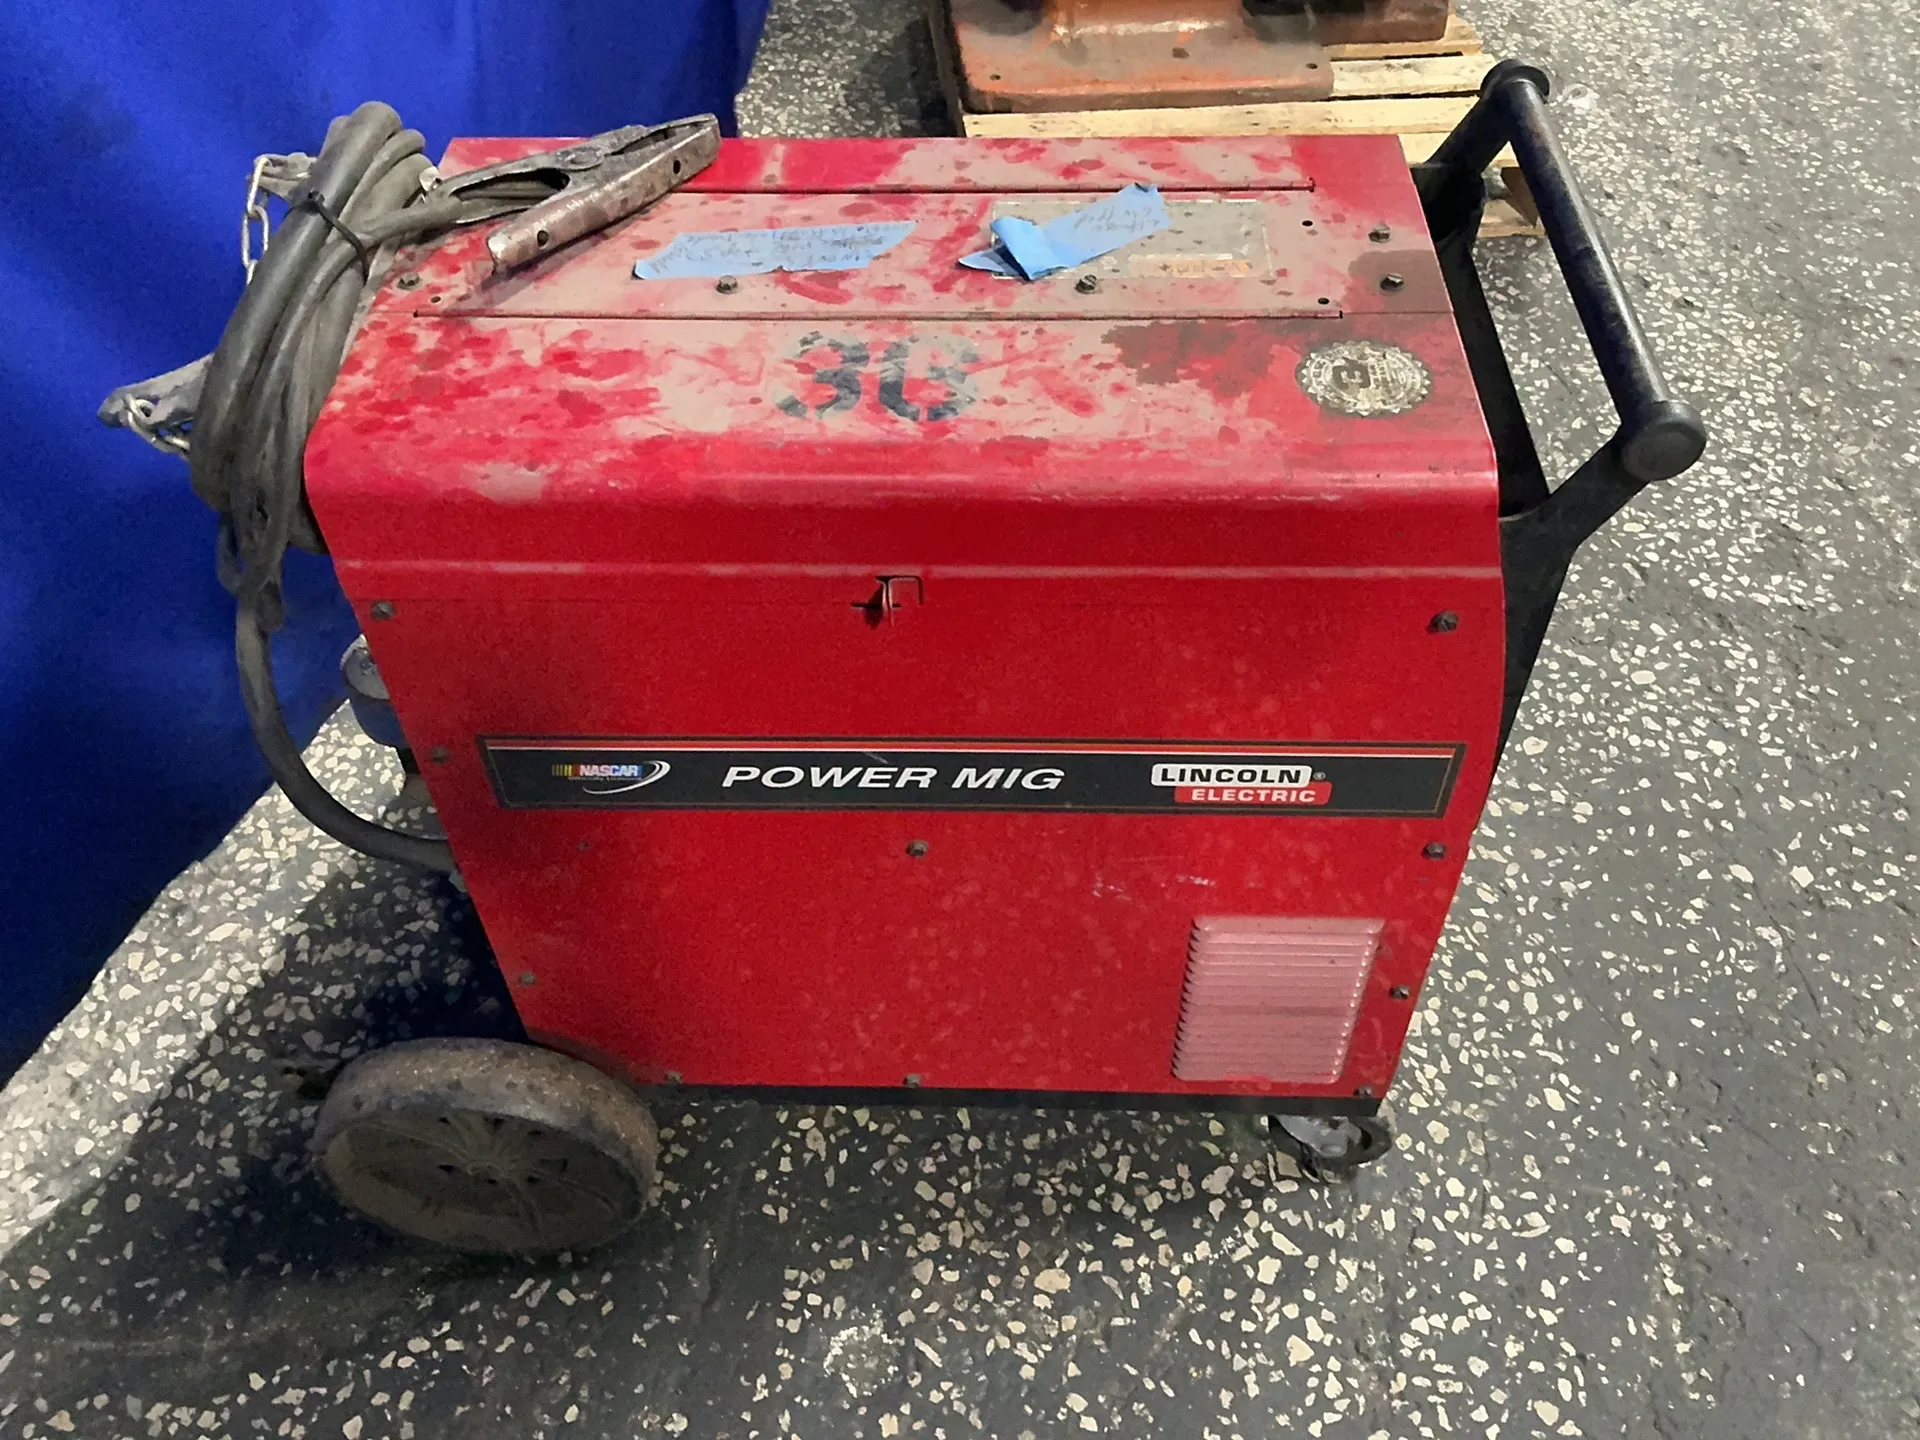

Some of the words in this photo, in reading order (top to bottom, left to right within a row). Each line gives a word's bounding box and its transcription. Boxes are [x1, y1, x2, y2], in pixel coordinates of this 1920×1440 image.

[579, 763, 639, 777] NASCAR
[1160, 768, 1301, 784] LINCOLN
[721, 766, 938, 789] POWER
[951, 767, 1066, 791] MIG
[1190, 788, 1317, 803] ELECTRIC
